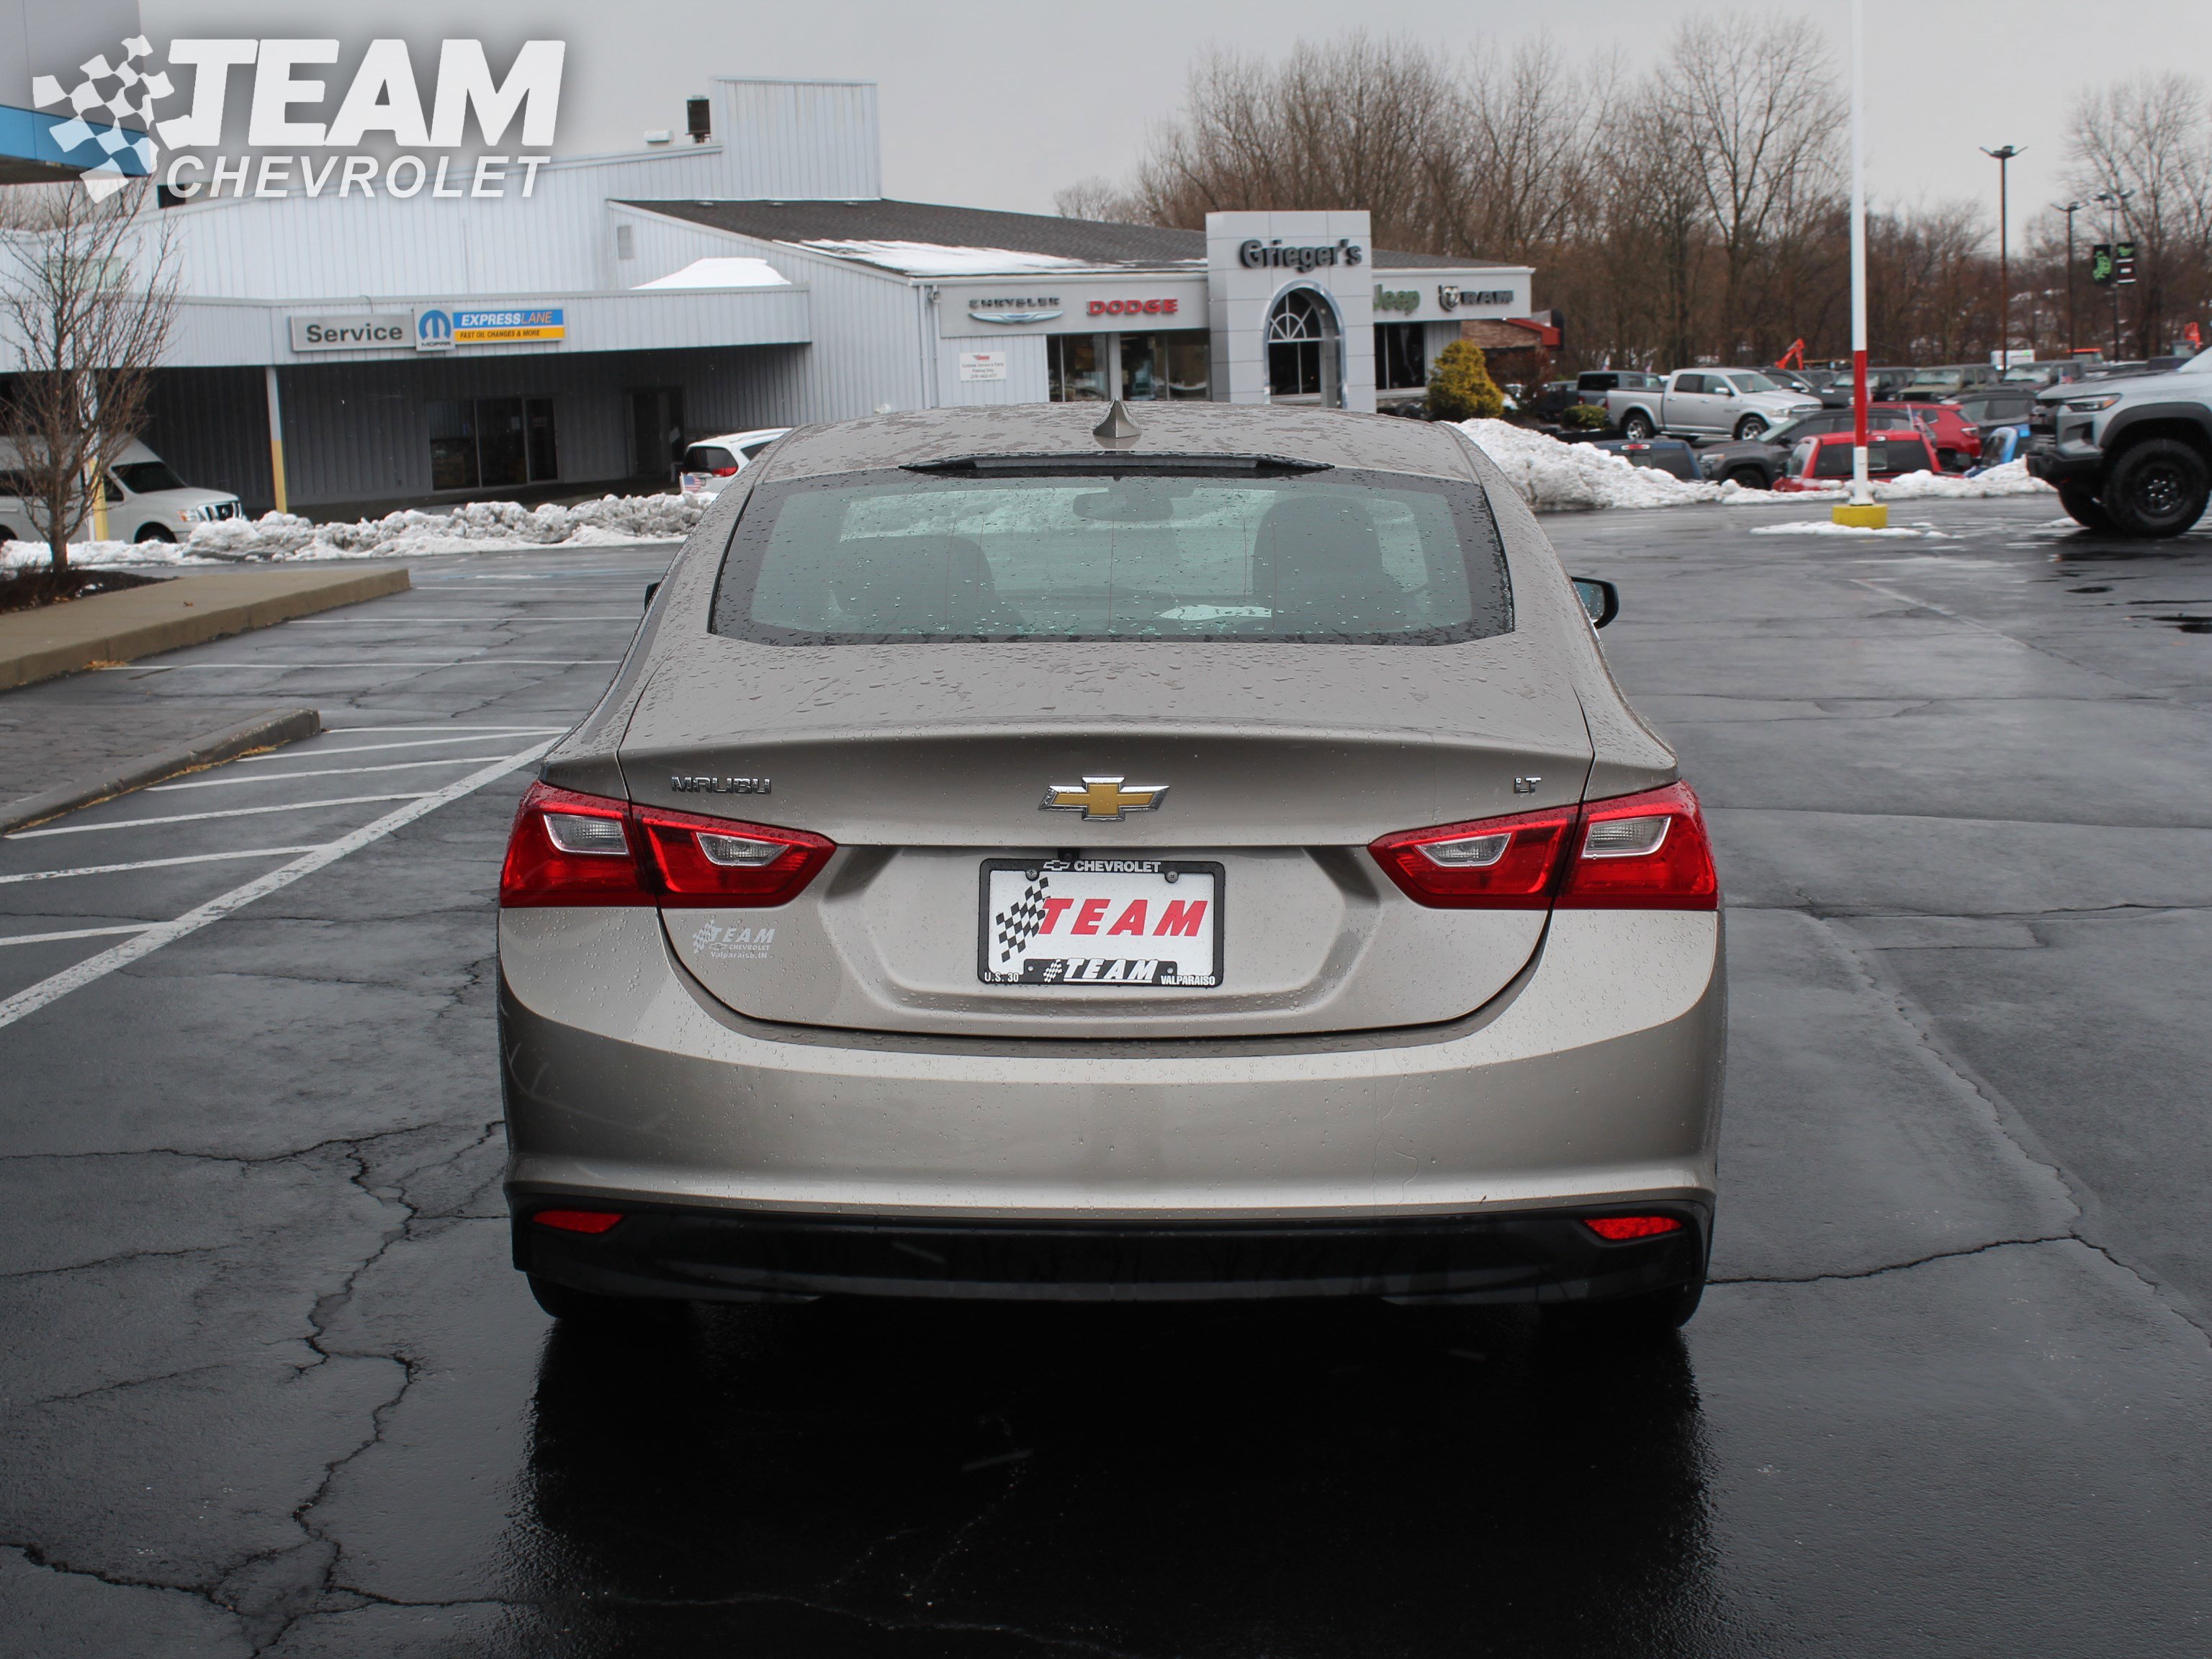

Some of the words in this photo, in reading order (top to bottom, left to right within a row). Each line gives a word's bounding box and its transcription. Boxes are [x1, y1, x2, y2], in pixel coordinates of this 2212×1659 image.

[1240, 238, 1362, 272] Grieger's
[968, 297, 1060, 309] CHRYSLER
[1460, 290, 1514, 305] RAM
[1087, 299, 1179, 316] DODGE
[306, 323, 403, 343] Service
[671, 776, 772, 793] MALIBU
[1514, 777, 1542, 793] LT
[1074, 860, 1161, 873] CHEVROLET
[1038, 898, 1208, 937] TEAM
[709, 927, 775, 943] TEAM
[1064, 958, 1159, 980] TEAM
[984, 972, 1005, 982] U.S.
[1007, 973, 1019, 983] 30
[1161, 975, 1215, 986] VALPARAISO
